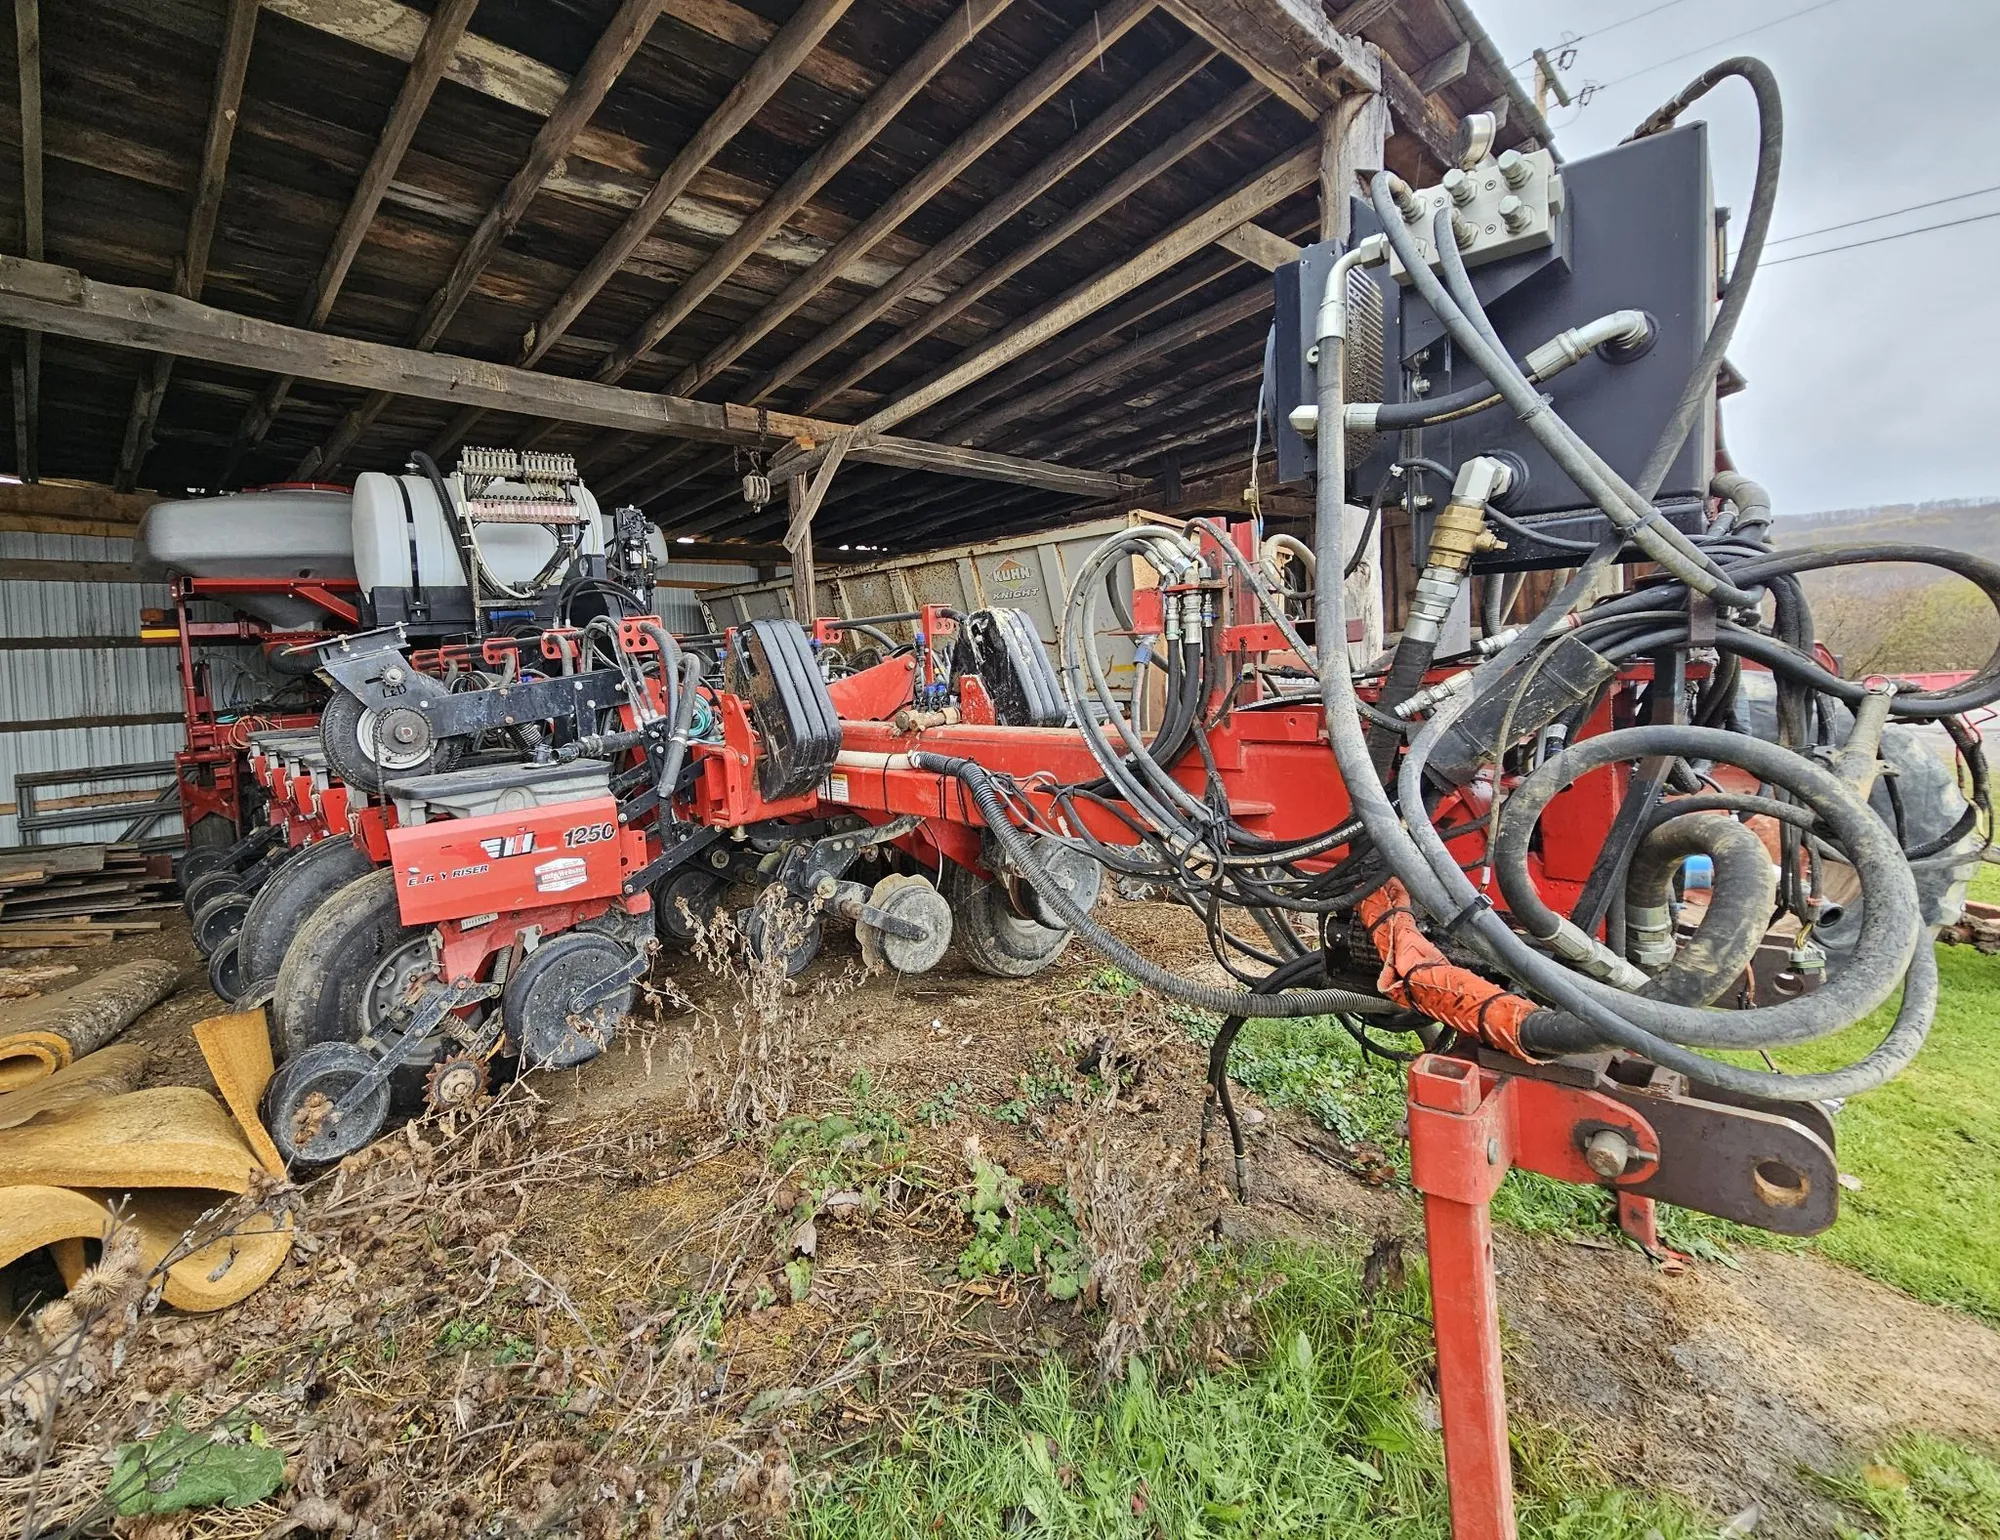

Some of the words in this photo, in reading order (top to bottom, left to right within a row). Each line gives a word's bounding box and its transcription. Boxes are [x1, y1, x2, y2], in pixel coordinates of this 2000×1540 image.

[993, 566, 1031, 582] KUHN
[993, 587, 1039, 600] KNIGHT
[563, 822, 616, 849] 1250
[407, 872, 447, 887] ERY
[451, 864, 489, 879] RISER
